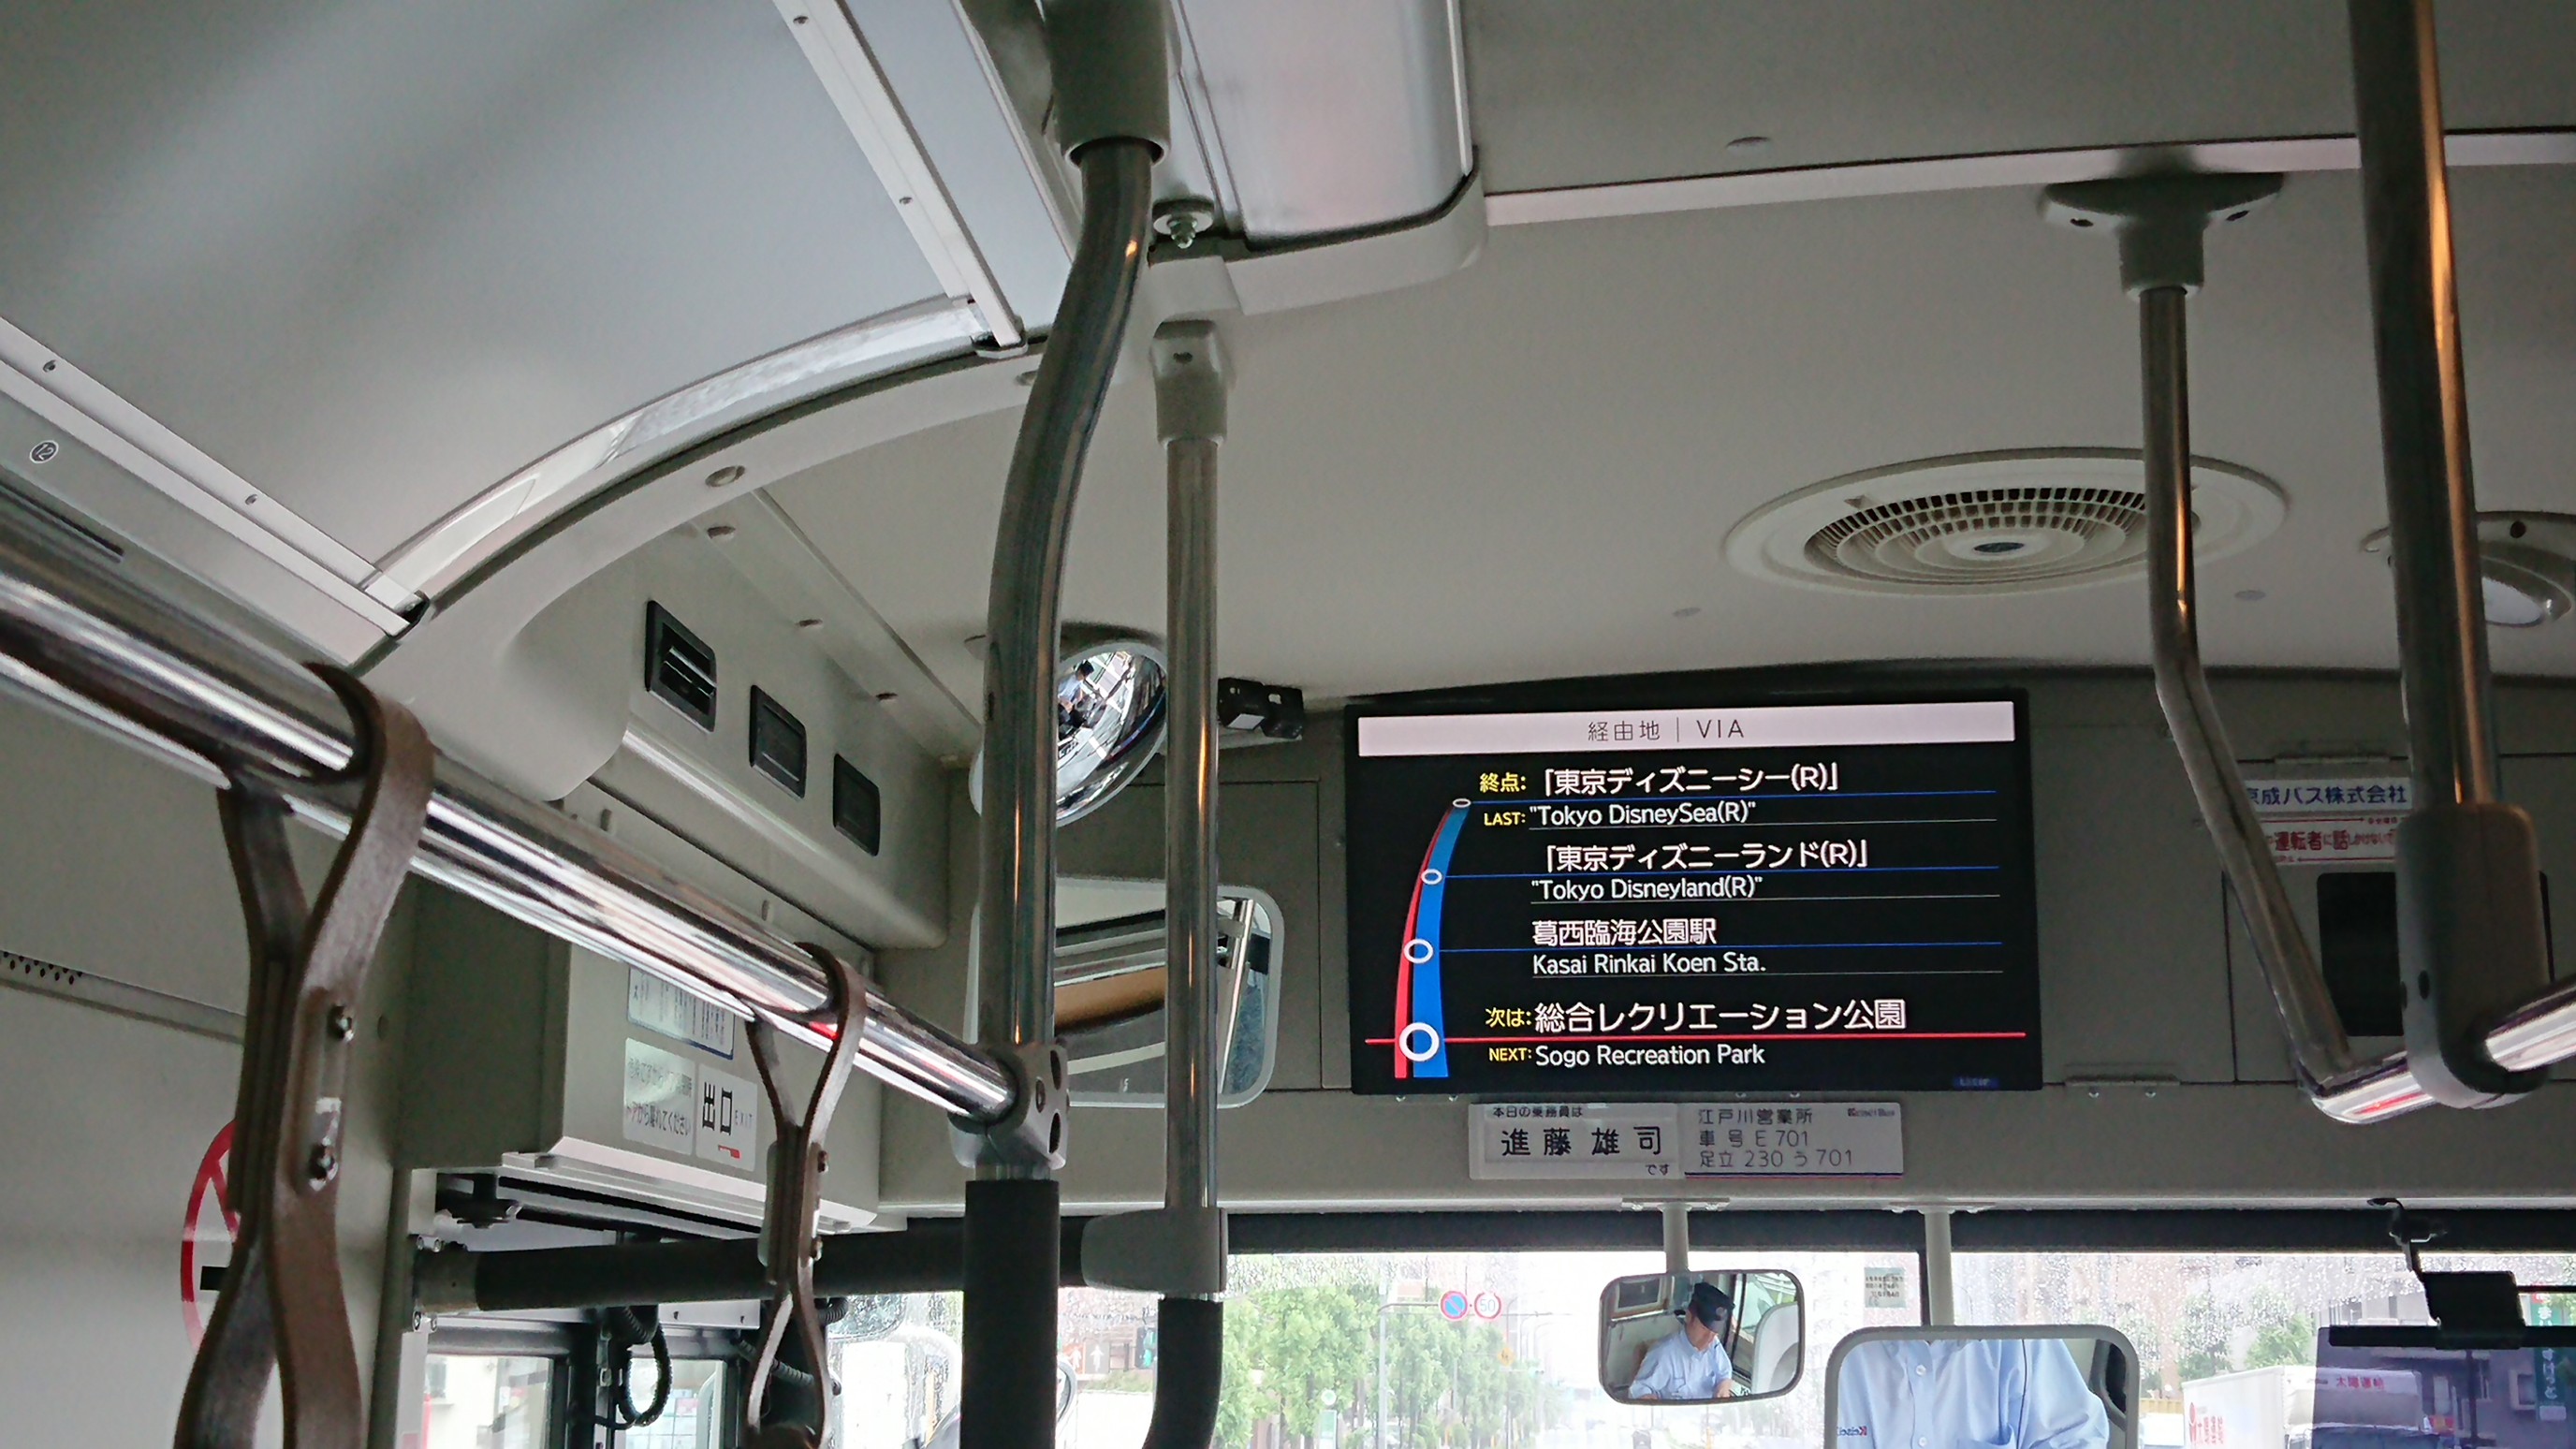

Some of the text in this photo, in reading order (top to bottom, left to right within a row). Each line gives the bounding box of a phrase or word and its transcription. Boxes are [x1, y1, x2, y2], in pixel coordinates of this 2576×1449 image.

[36, 444, 54, 461] 12
[1588, 719, 1745, 742] 経由地 VIA
[1479, 761, 1838, 797] 終点: 「東京ディズニーシー(R)」
[1484, 799, 1757, 827] LAST: "Tokyo DisneySea(R)"
[1546, 839, 1868, 872] 「東京ディズニーランド(R)」
[1531, 875, 1763, 901] "Tokyo Disneyland(R)"
[1531, 918, 1718, 947] 葛西臨海公園駅
[1532, 951, 1767, 975] Kasai Rinkai Koen Sta.
[1485, 998, 1907, 1032] 次は: 総合レクリエーション公園
[1488, 1042, 1766, 1069] NEXT: Sogo Recreation Park
[702, 1081, 733, 1136] 出口
[1698, 1107, 1812, 1125] 江戸川営業所
[1775, 1129, 1808, 1148] 701
[1645, 1164, 1670, 1176] です
[1700, 1149, 1852, 1168] 足立 230 う 701
[1480, 1298, 1496, 1312] 50
